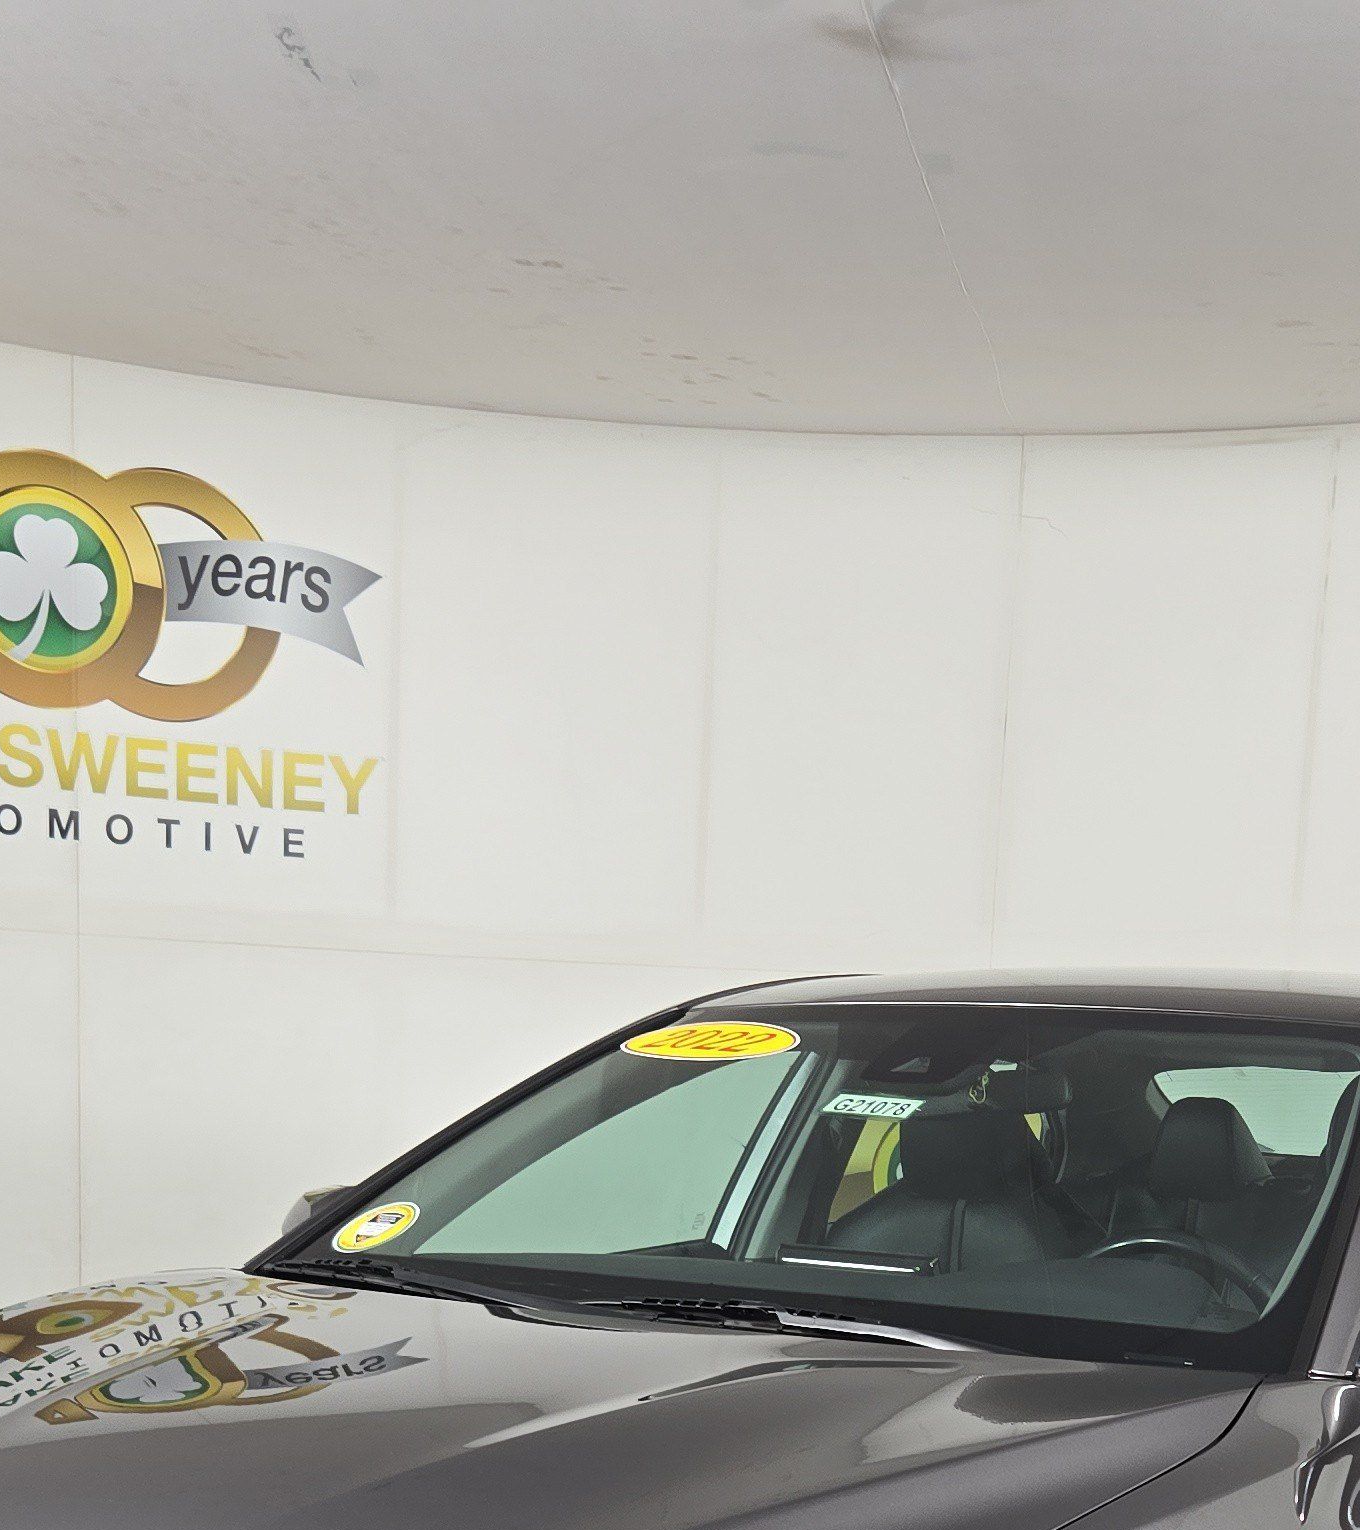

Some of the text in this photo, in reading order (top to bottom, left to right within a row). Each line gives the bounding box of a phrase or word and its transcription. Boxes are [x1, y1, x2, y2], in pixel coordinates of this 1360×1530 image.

[175, 552, 333, 614] years
[642, 1029, 778, 1053] 2022
[833, 1098, 912, 1116] G21078
